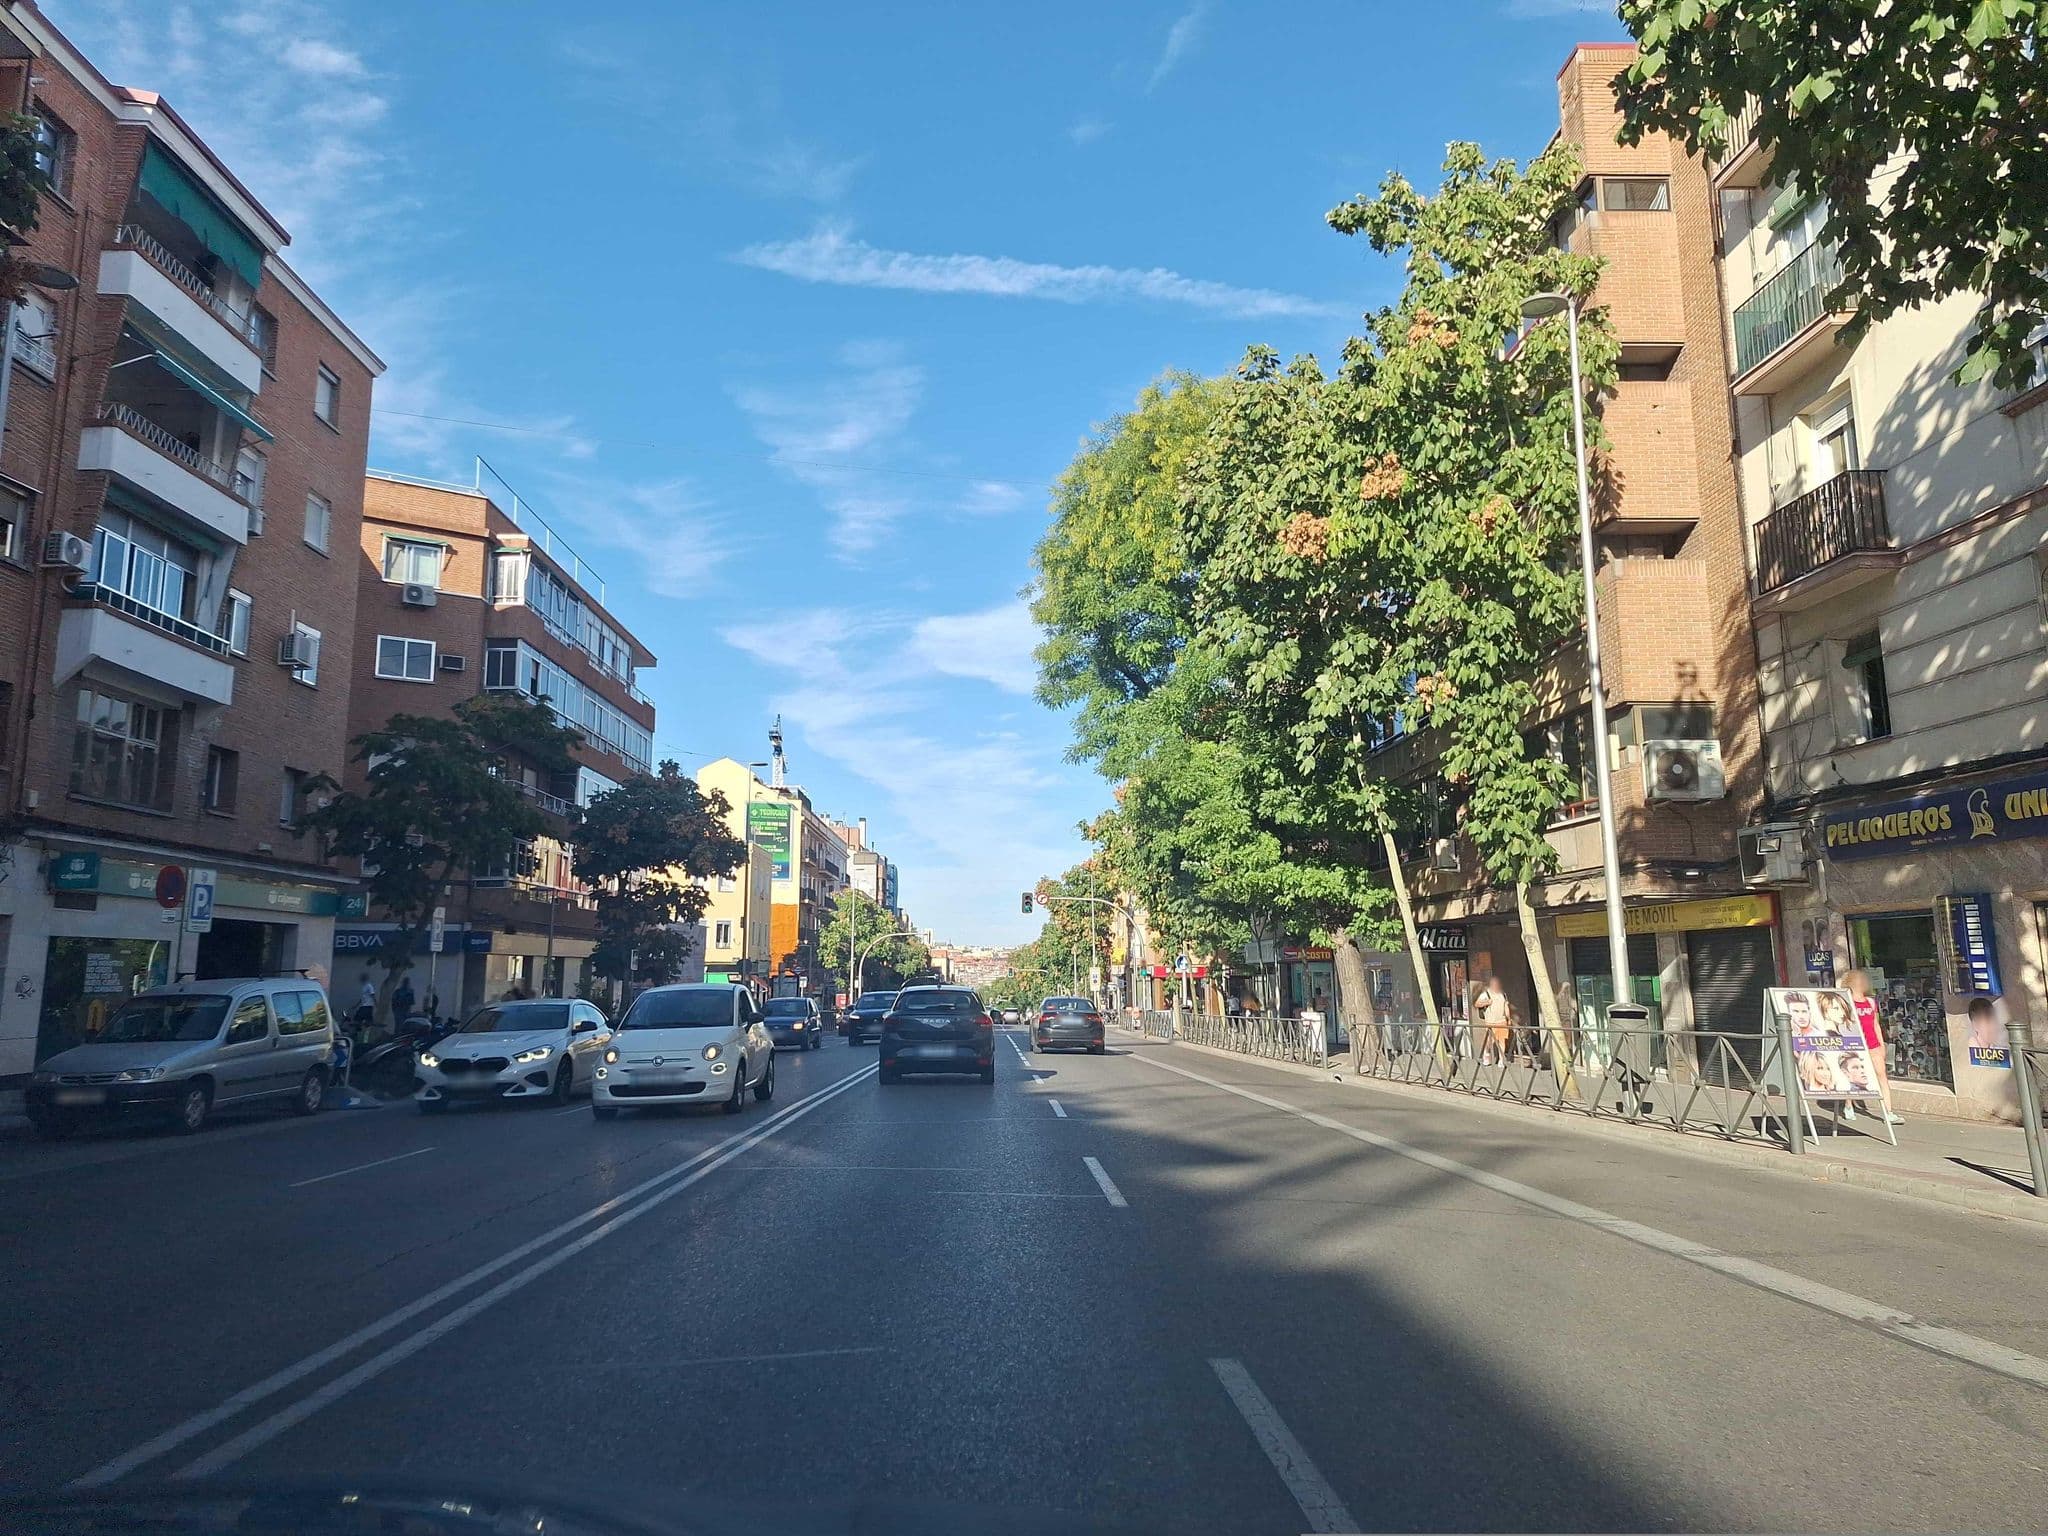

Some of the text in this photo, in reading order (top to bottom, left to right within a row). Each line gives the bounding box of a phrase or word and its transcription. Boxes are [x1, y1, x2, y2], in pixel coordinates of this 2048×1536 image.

[1827, 804, 1952, 847] PELUQUEROS
[2005, 788, 2048, 819] UNI
[193, 887, 208, 917] P
[335, 934, 384, 948] BBVA
[1417, 927, 1466, 949] Uñas
[1808, 952, 1830, 962] LUCAS
[1809, 1037, 1844, 1046] LUCAS
[1974, 1048, 2005, 1061] LUCAS
